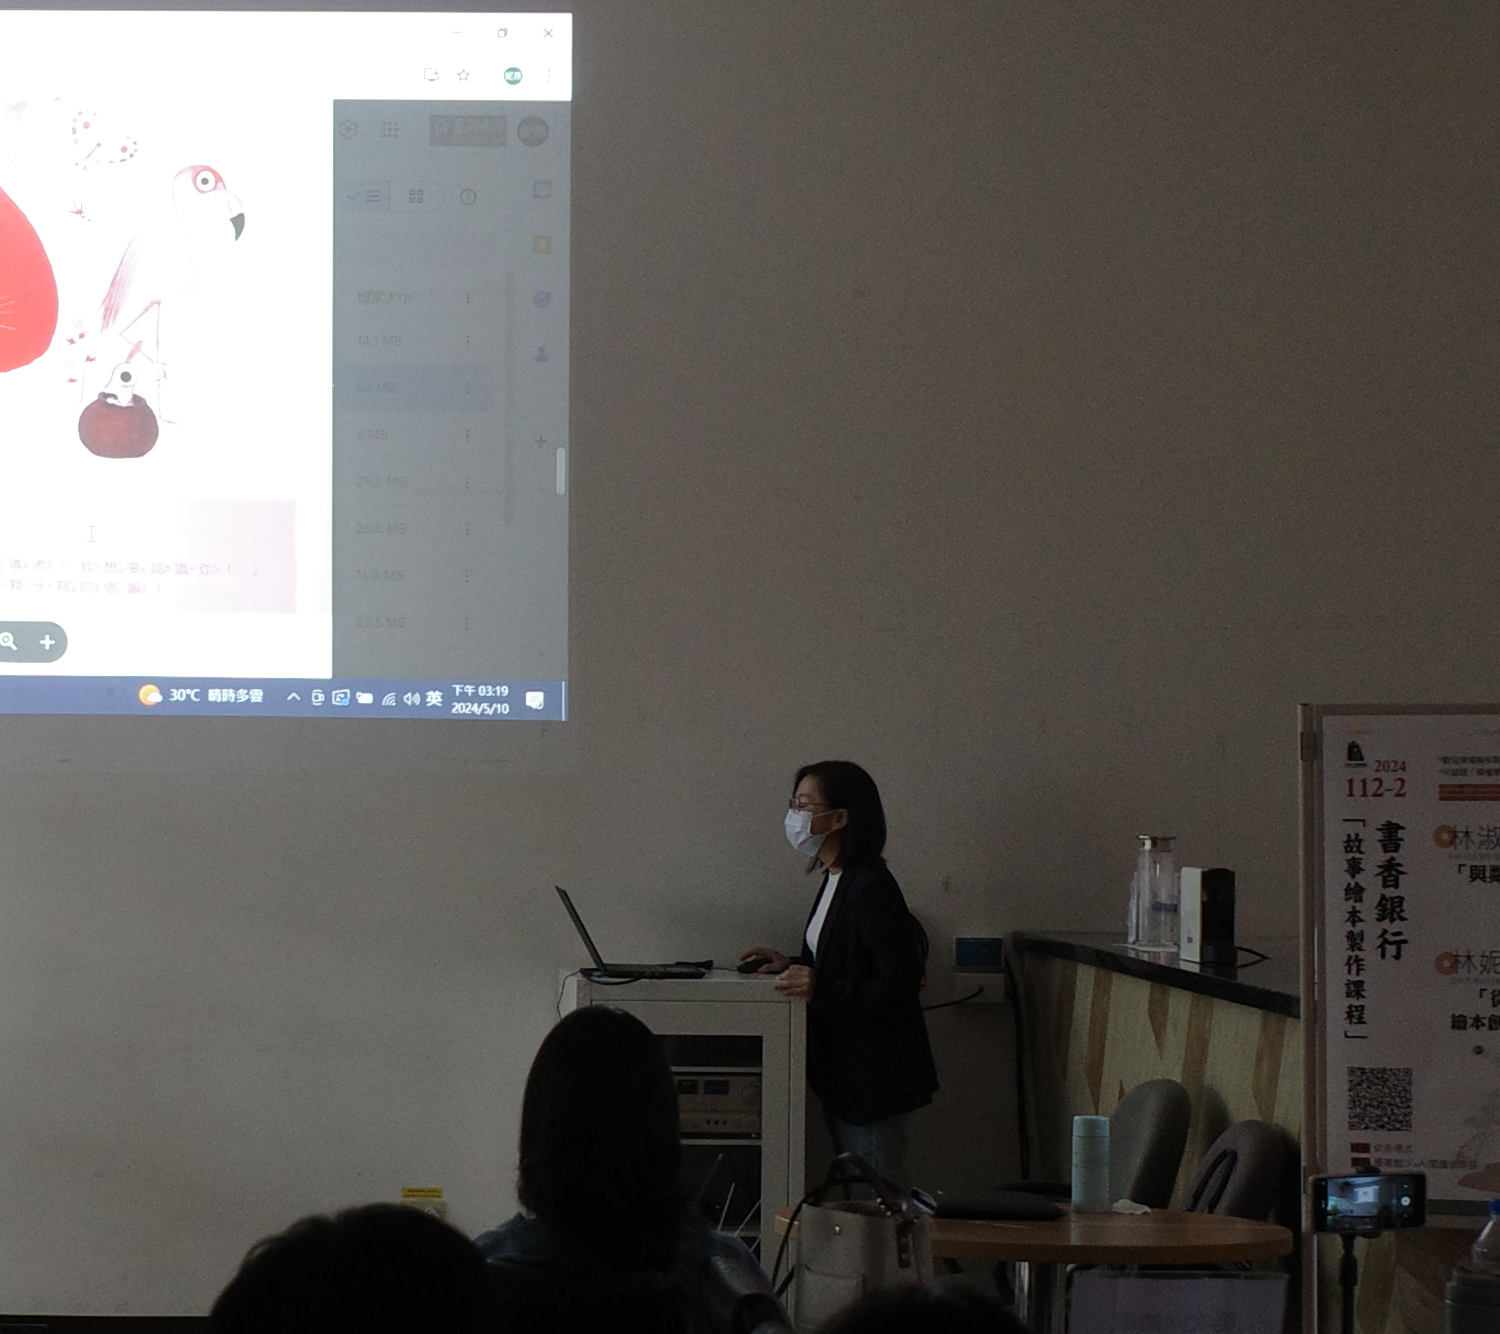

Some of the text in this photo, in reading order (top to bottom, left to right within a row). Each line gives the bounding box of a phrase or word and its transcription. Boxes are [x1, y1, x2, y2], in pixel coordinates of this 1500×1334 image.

[169, 688, 264, 703] 30°C 晴時多雲
[425, 690, 443, 706] 英
[451, 684, 509, 697] 下午 03:19
[451, 703, 510, 716] 2024/5/10
[1374, 760, 1407, 772] 2024
[1346, 777, 1407, 797] 112-2
[1376, 820, 1409, 961] 書香銀行
